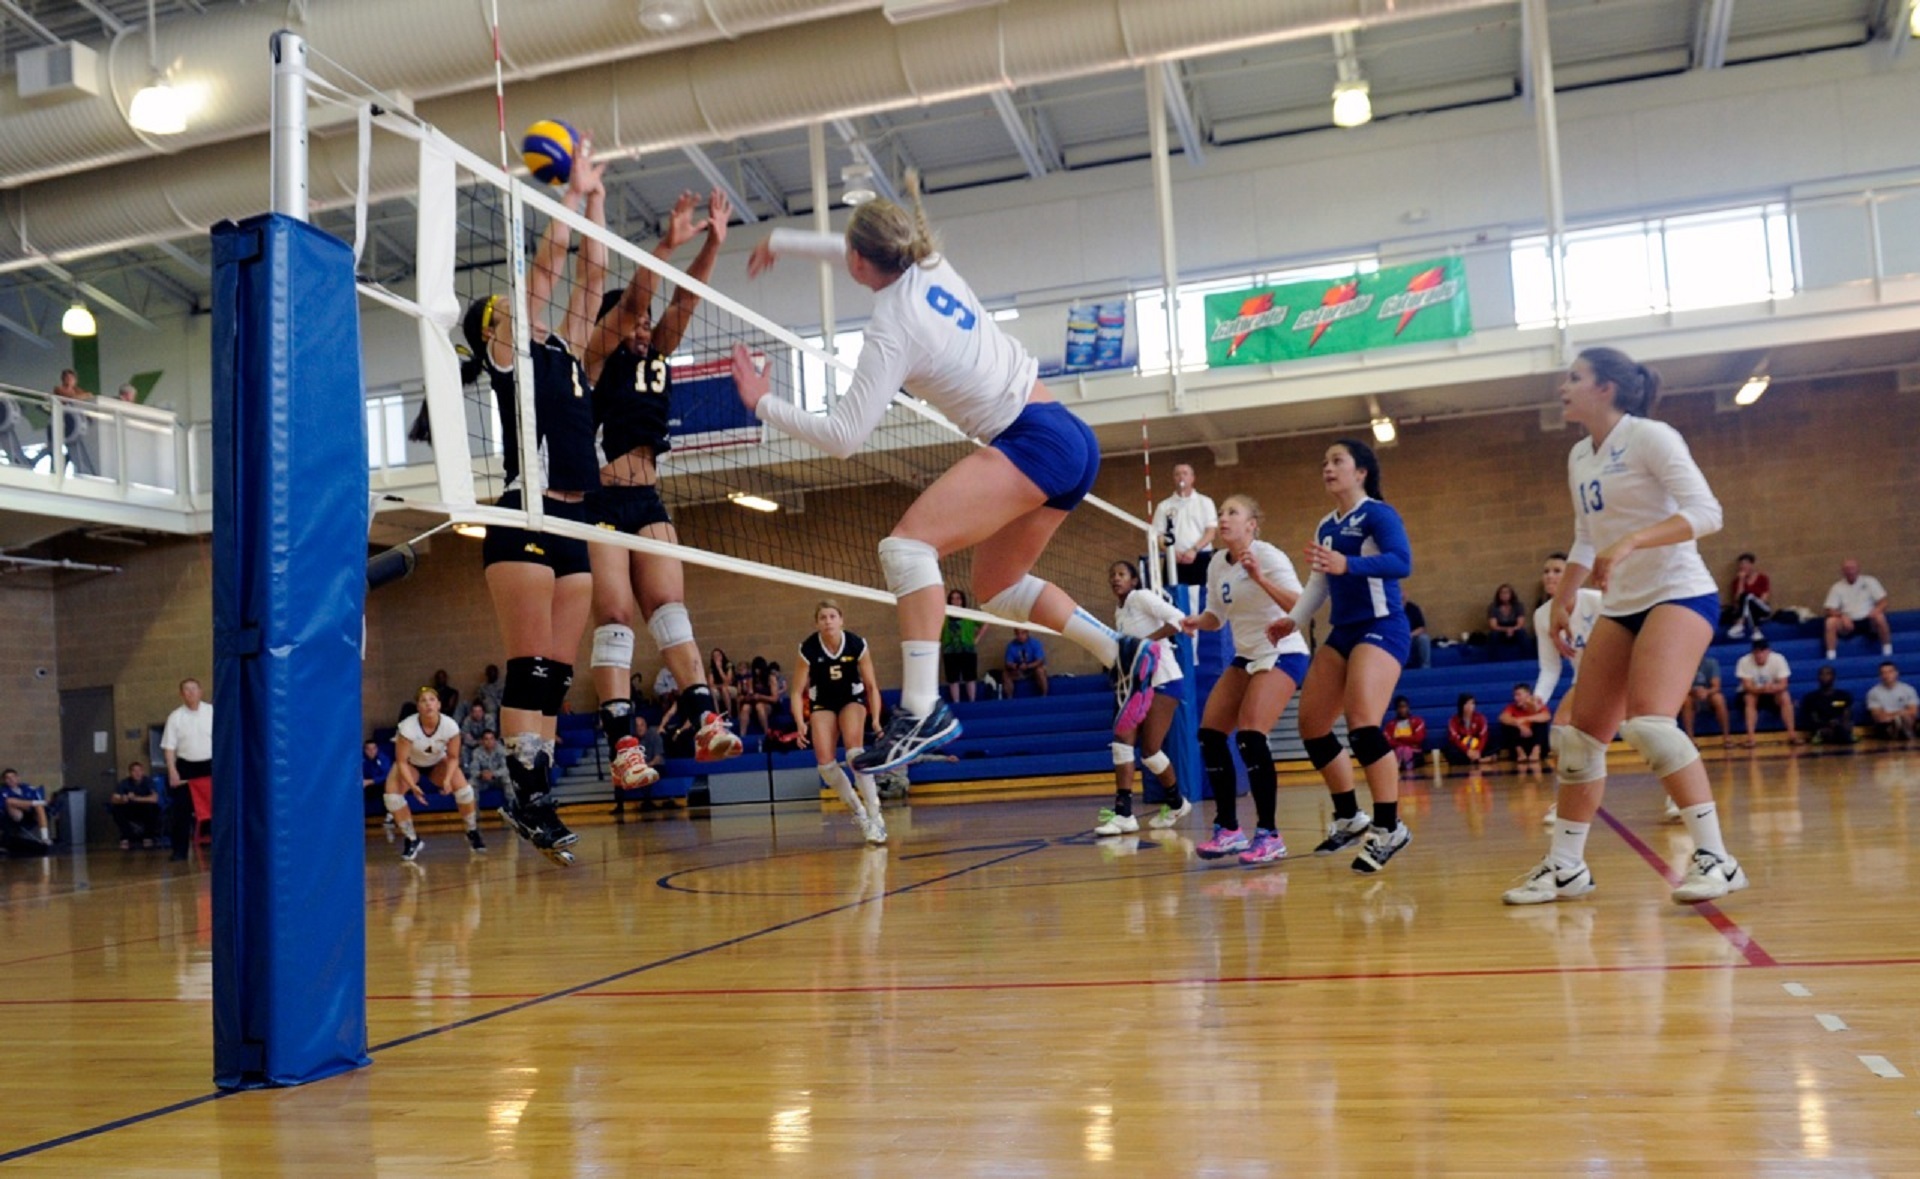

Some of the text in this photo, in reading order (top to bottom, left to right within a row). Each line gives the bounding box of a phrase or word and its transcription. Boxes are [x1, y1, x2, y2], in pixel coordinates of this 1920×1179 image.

[926, 285, 976, 331] 9
[1292, 294, 1374, 331] Gatorade
[1377, 279, 1459, 320] Gatorade
[634, 359, 667, 394] 13
[1580, 480, 1604, 514] 13
[1222, 582, 1233, 604] 2
[829, 664, 843, 680] 5
